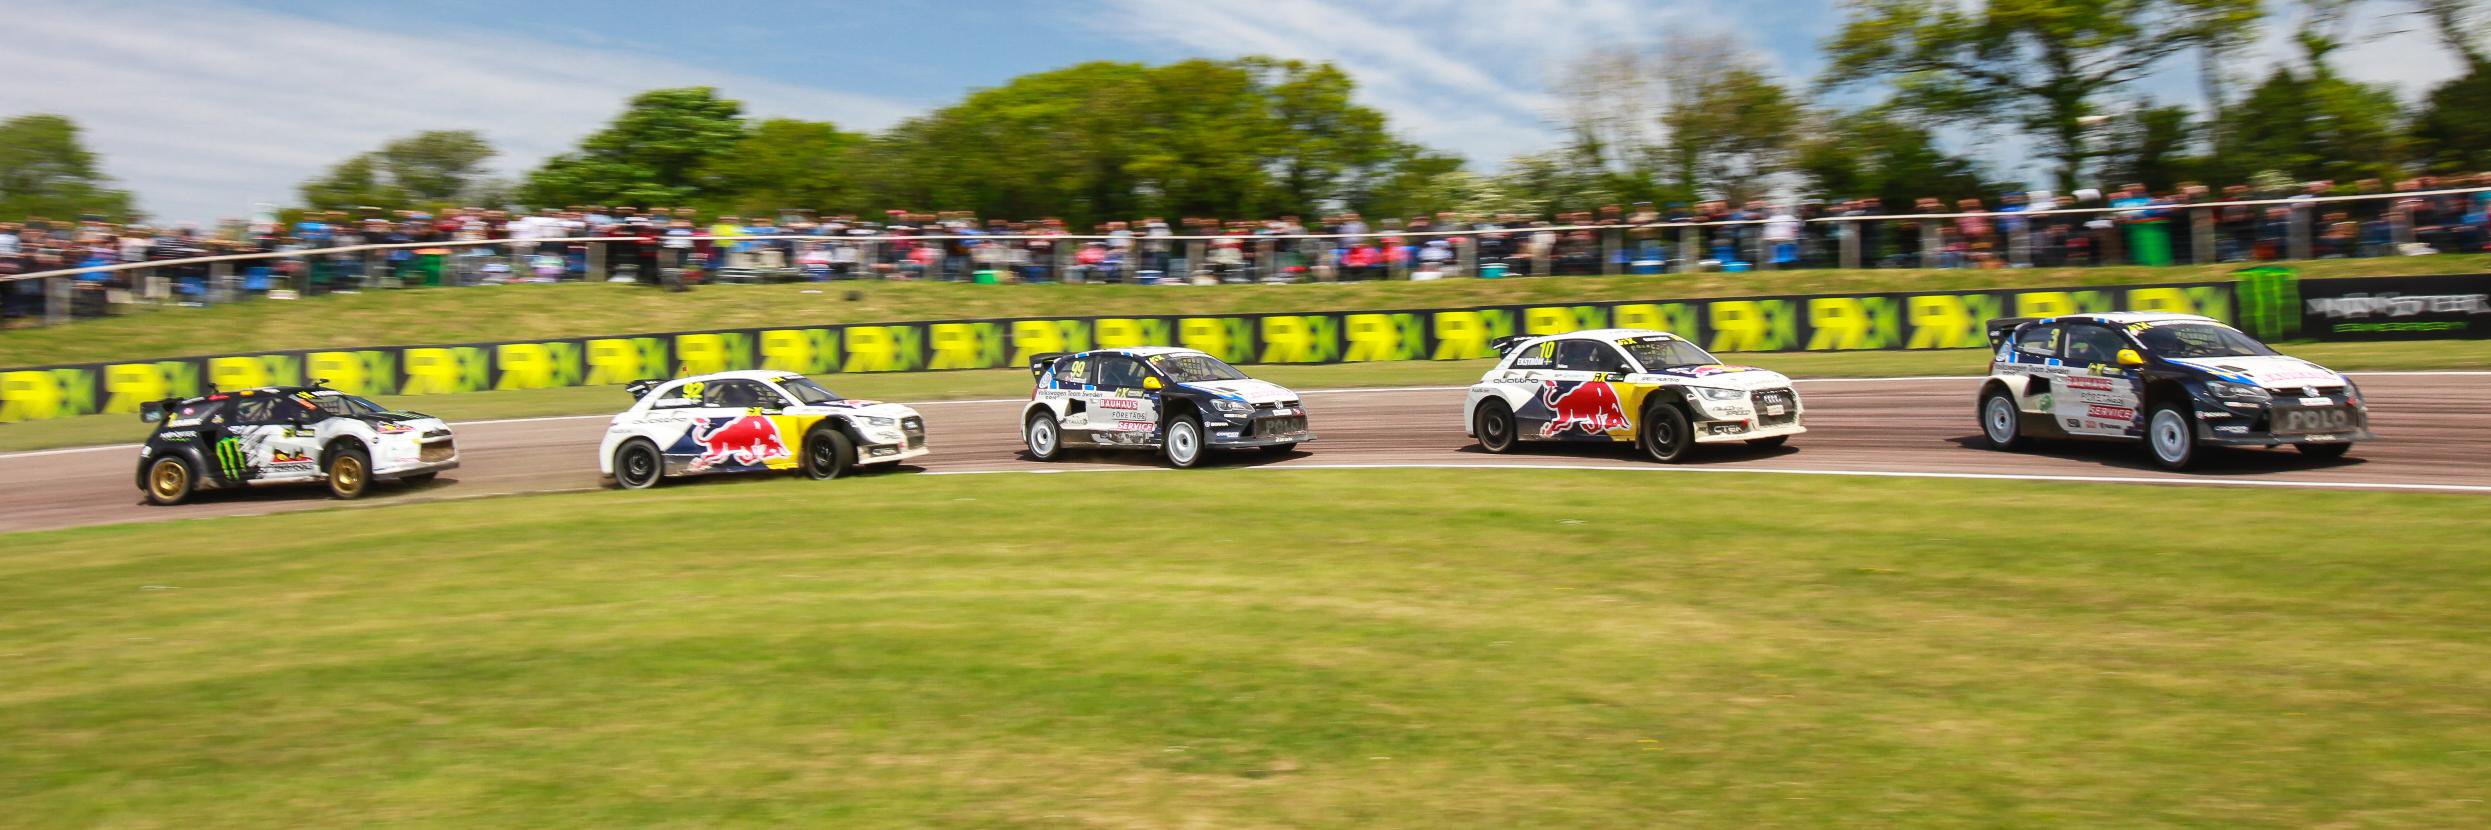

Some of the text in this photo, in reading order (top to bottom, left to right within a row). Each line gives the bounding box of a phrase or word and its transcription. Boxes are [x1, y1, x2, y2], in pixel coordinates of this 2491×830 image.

[1540, 341, 1556, 359] 10
[1517, 356, 1544, 366] EKSTRÖM
[1071, 361, 1086, 378] 99
[1100, 399, 1138, 410] BAUHAUS
[2089, 405, 2133, 420] SERVICE
[1119, 422, 1154, 431] SERVICE
[2288, 411, 2348, 430] POLO
